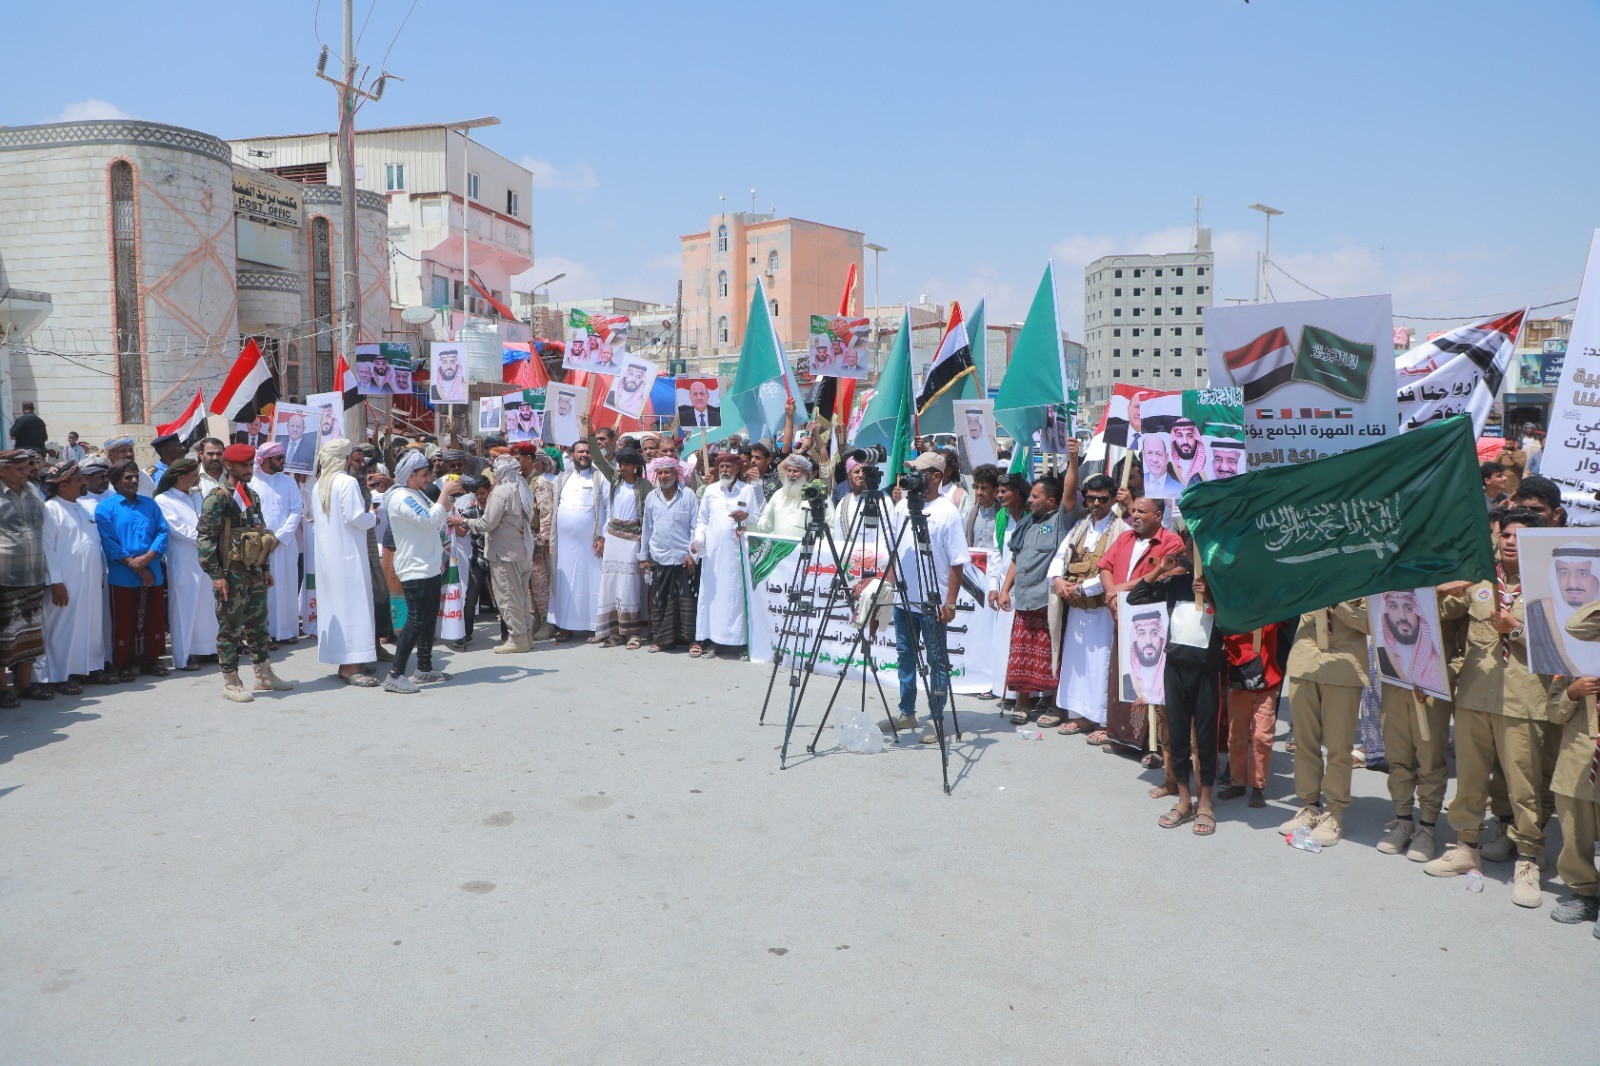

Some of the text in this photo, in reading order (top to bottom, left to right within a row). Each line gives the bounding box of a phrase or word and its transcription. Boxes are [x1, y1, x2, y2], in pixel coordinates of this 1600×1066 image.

[238, 197, 264, 213] POST
[268, 206, 291, 219] OFFIC
[276, 195, 298, 210] مكتب
[1266, 424, 1306, 439] الجامع
[1310, 424, 1354, 439] المهرة
[1358, 424, 1387, 437] لقاء
[1287, 448, 1353, 464] ملكة
